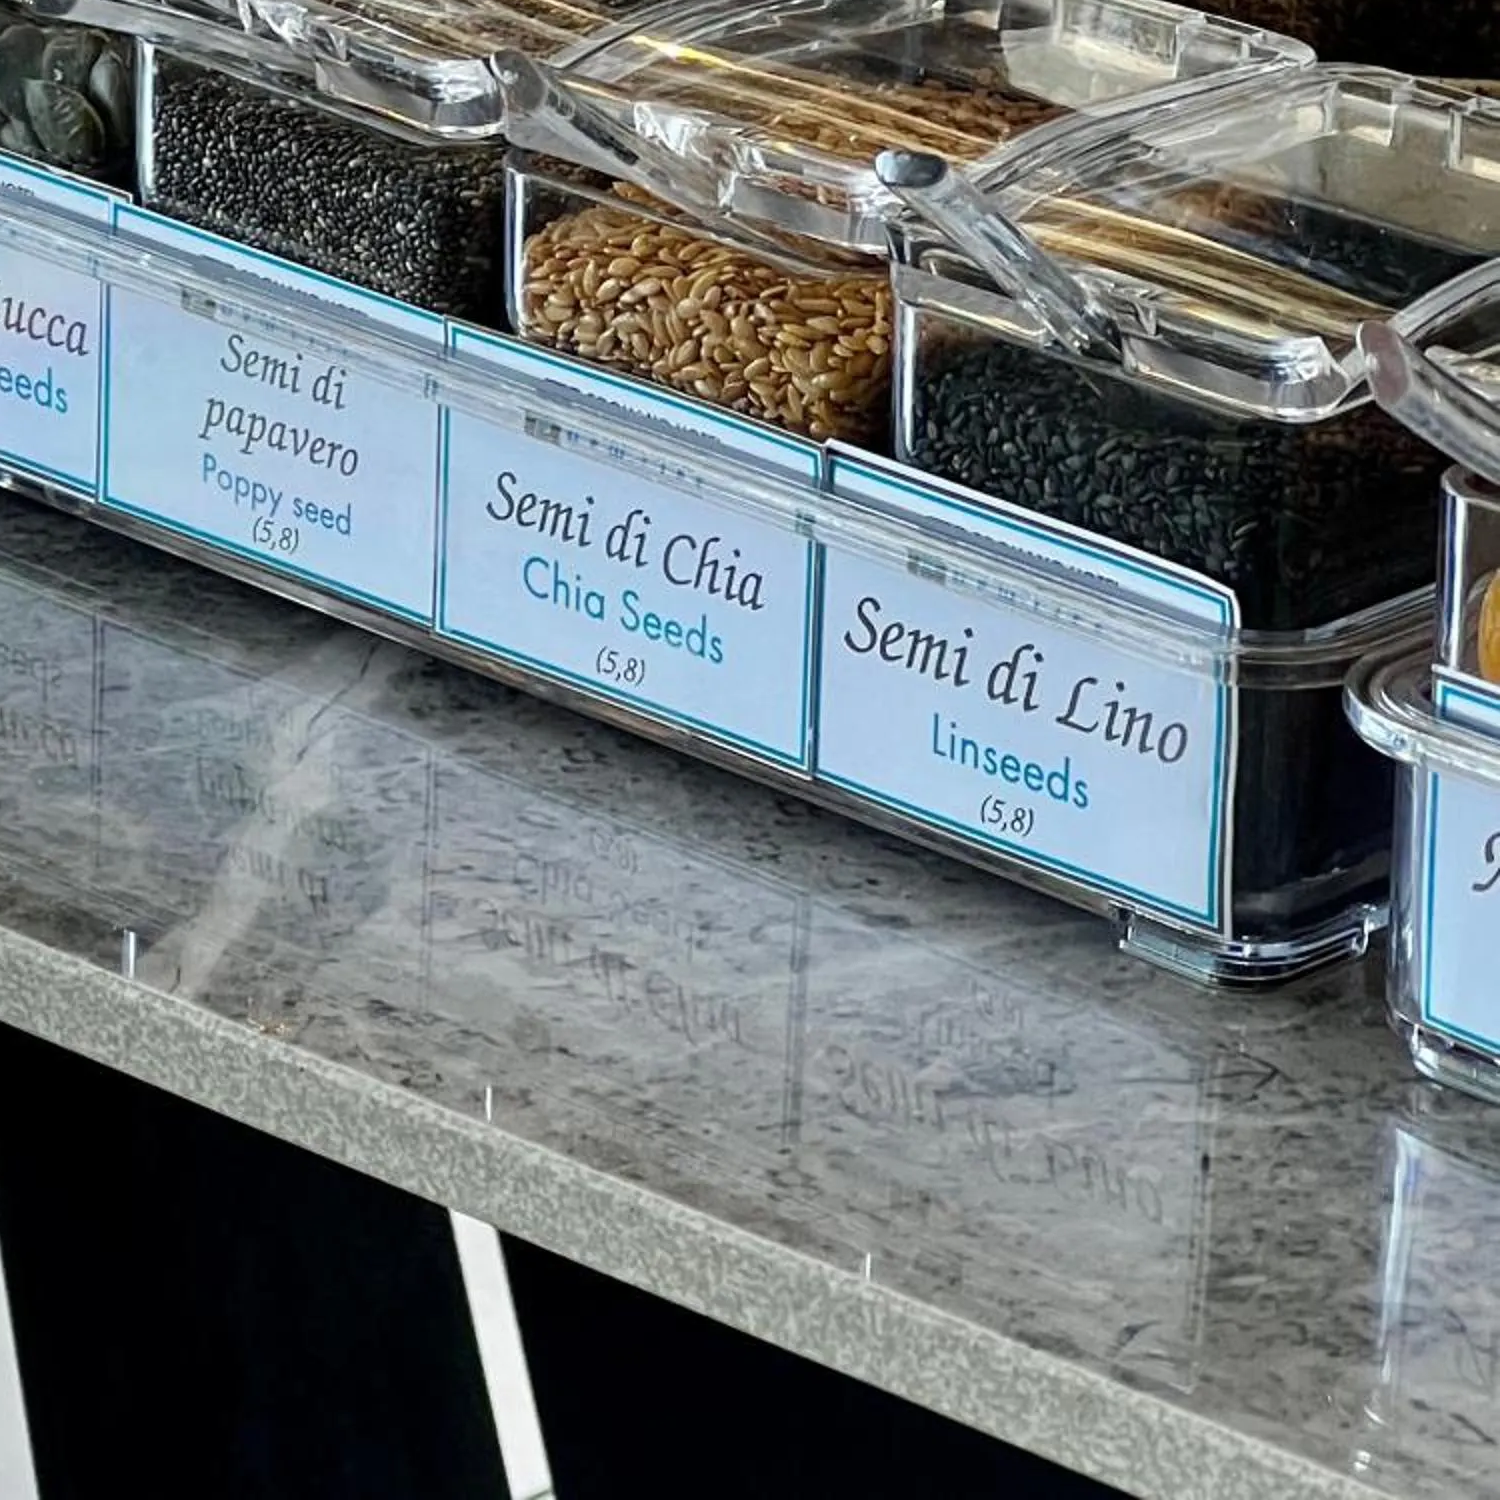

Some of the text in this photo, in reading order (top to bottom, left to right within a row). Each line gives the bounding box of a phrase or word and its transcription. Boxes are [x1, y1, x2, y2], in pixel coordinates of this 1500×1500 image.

[219, 333, 347, 410] Semi di
[199, 395, 358, 477] papavero
[202, 453, 351, 536] Poppy seed
[252, 515, 299, 554] (5,8)
[485, 471, 765, 611] Semi di Chia
[522, 556, 724, 665] Chia Seeds
[595, 645, 646, 687] (5,8)
[843, 597, 1188, 765] Semi di Lino
[932, 713, 1090, 809] Linseeds
[980, 795, 1035, 837] (5,8)
